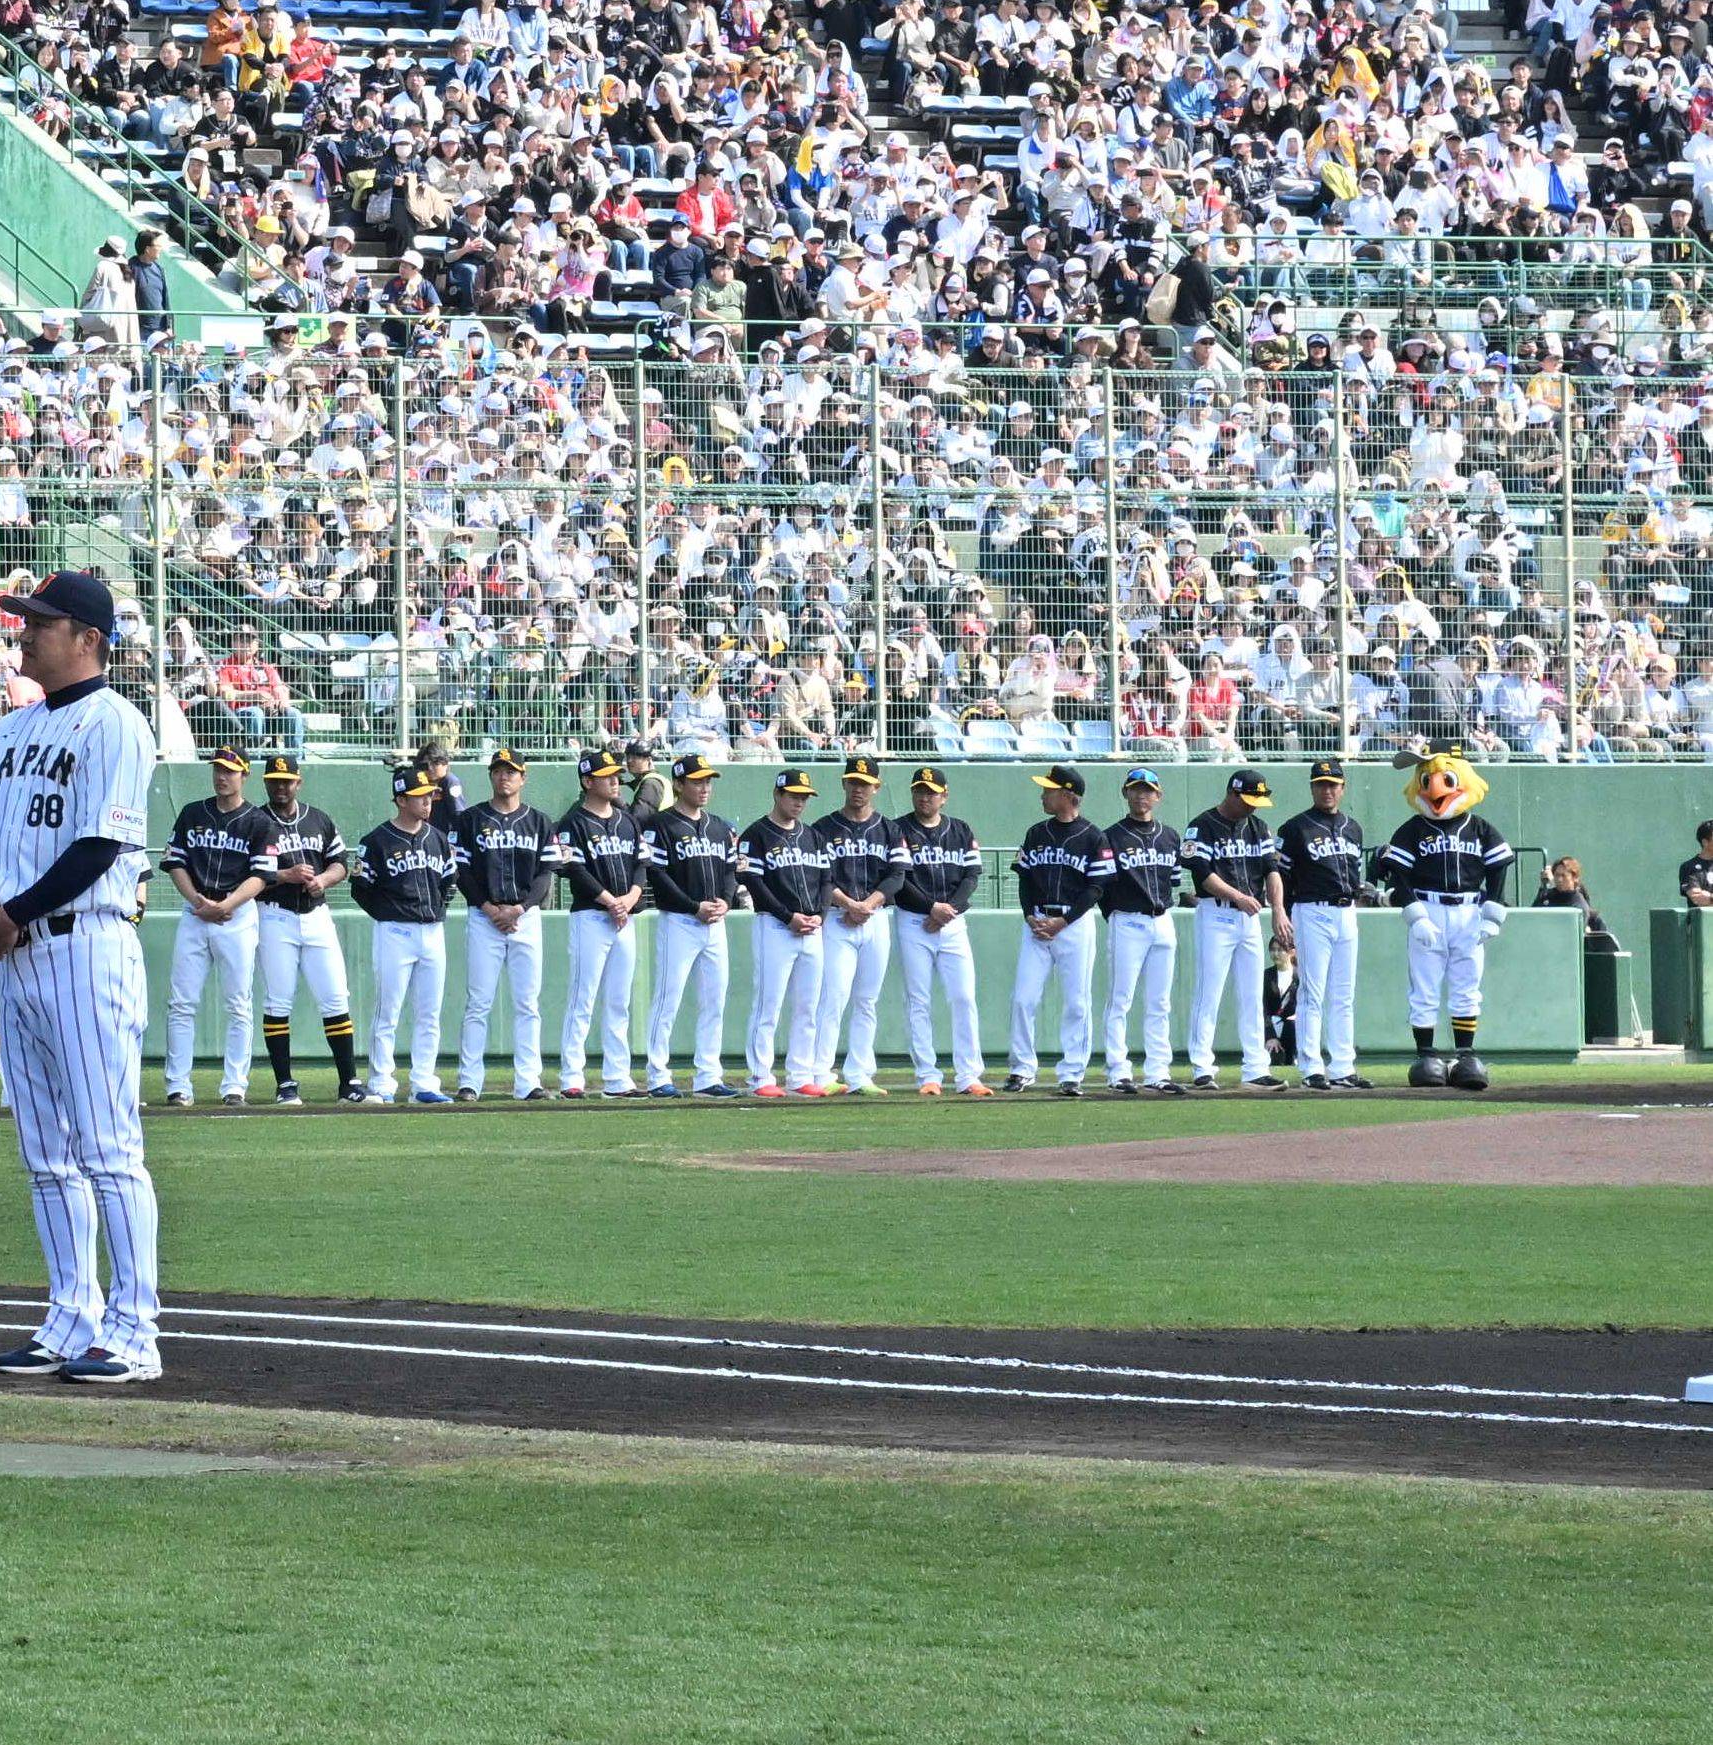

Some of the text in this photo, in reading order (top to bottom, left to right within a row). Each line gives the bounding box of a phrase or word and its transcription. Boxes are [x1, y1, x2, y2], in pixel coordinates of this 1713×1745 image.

[27, 793, 64, 829] 88
[276, 831, 323, 854] oftBank
[587, 834, 635, 860] SoftBan
[913, 844, 966, 866] oftBank
[1418, 833, 1483, 857] SoftBank
[1029, 844, 1088, 874] SoftBank
